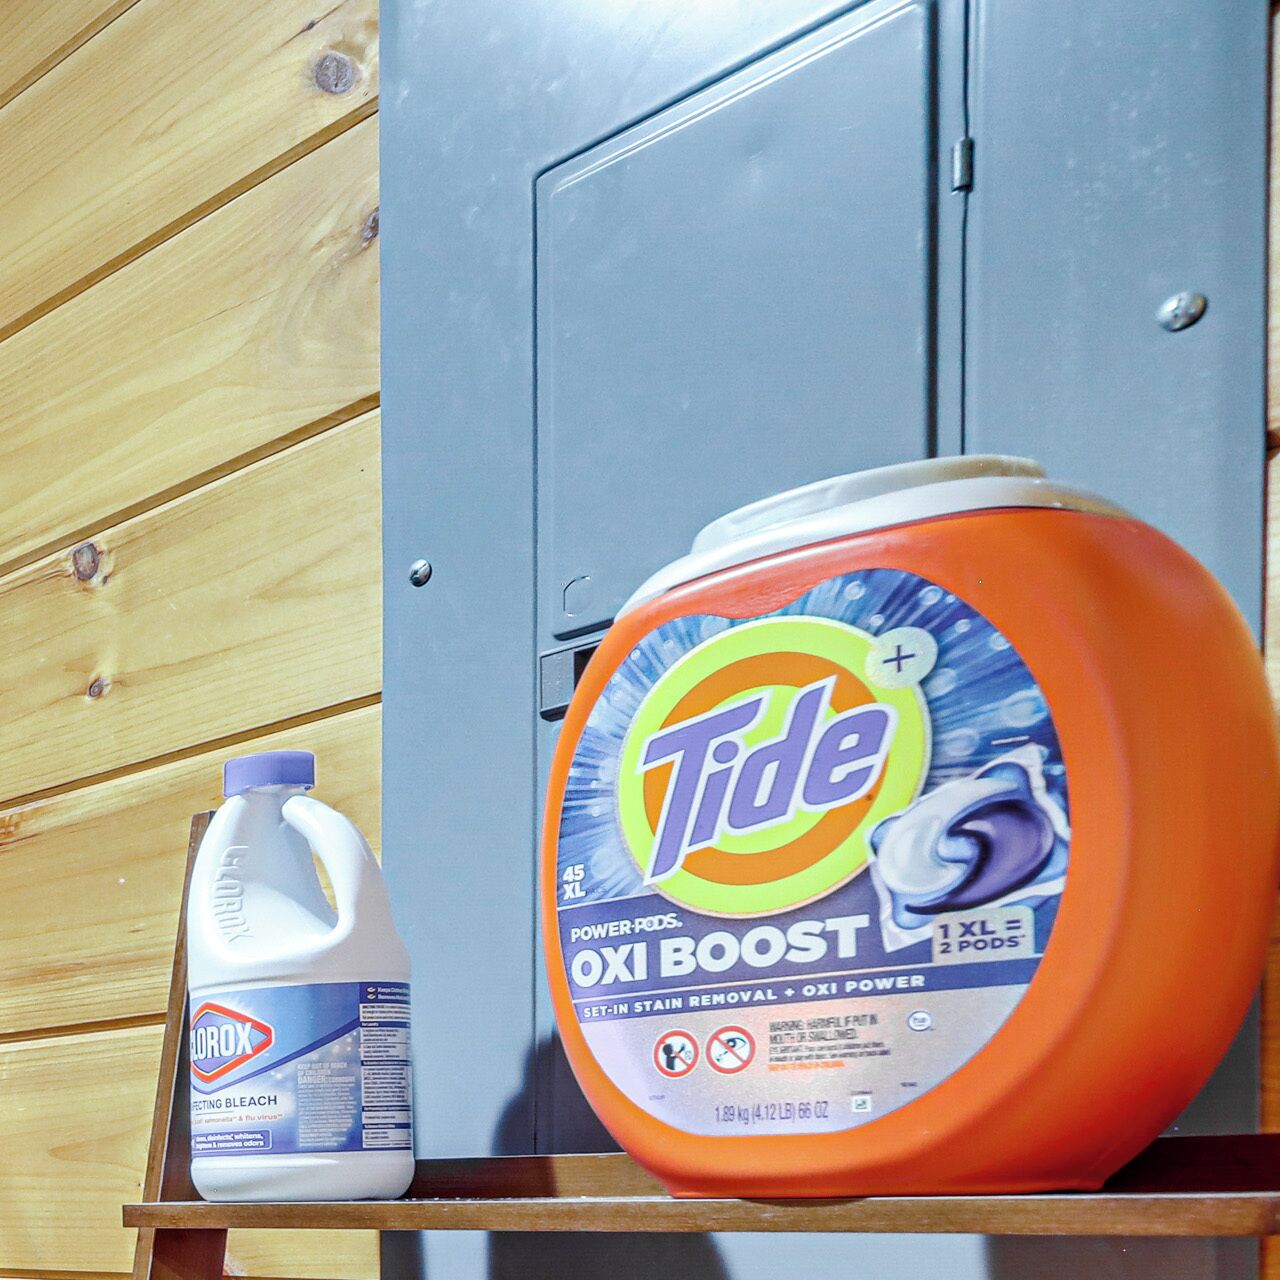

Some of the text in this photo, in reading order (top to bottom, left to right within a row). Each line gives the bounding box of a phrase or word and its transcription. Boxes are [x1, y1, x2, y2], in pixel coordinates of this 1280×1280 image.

[638, 676, 898, 885] Tide
[562, 863, 586, 882] 45
[562, 881, 587, 900] XL
[571, 918, 632, 943] POWER
[939, 923, 949, 939] 1
[958, 919, 996, 939] XL
[571, 914, 870, 988] OXI BOOST
[939, 942, 952, 955] 2
[583, 1003, 629, 1019] SET-IN
[634, 996, 683, 1013] STAIN
[689, 988, 778, 1007] REMOVAL
[802, 983, 838, 998] OXI
[845, 974, 926, 993] POWER
[191, 1022, 254, 1061] LOROX
[225, 1094, 278, 1109] BLEACH
[715, 1105, 735, 1123] 1.89
[798, 1101, 812, 1120] 66
